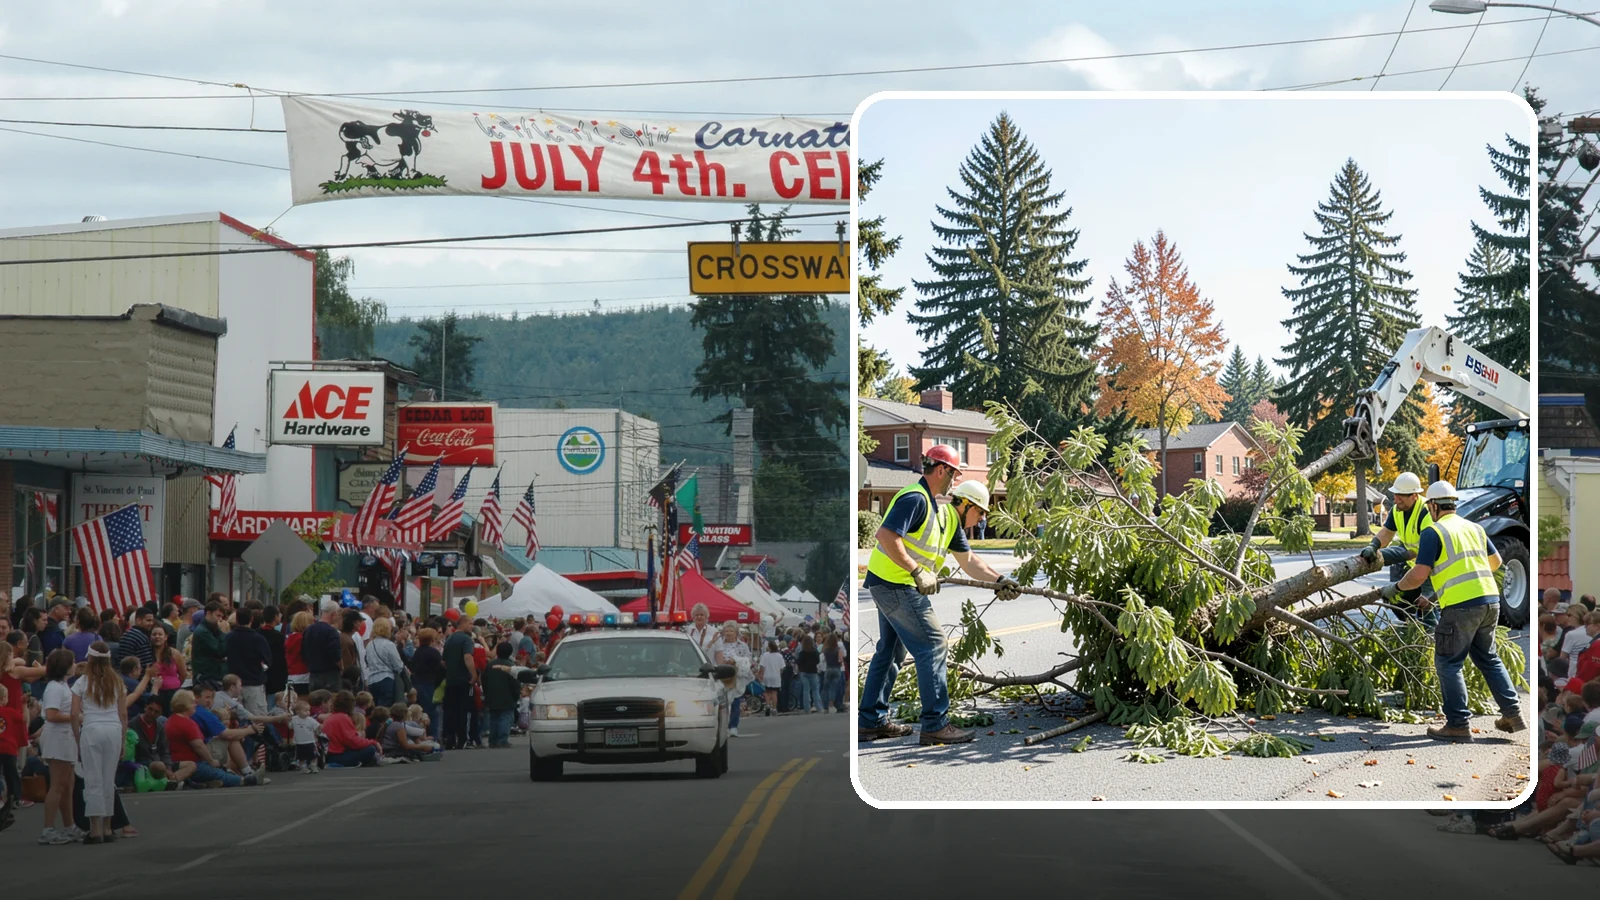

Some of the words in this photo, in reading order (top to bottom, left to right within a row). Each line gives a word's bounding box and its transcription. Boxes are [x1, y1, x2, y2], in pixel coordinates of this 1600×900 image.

[695, 121, 850, 150] Carnat
[481, 141, 605, 193] JULY
[632, 149, 746, 198] 4th.
[697, 254, 850, 280] CROSSWA
[283, 380, 373, 420] ACE
[406, 410, 452, 421] CEDAR
[283, 421, 371, 436] Hardware
[416, 428, 477, 447] Coca-Cola
[353, 466, 385, 480] Simpl
[83, 484, 93, 494] St.
[95, 485, 124, 495] Vincent
[126, 486, 136, 495] de
[137, 486, 155, 495] Paul
[688, 526, 741, 535] CRNATION
[699, 535, 730, 543] GLASS
